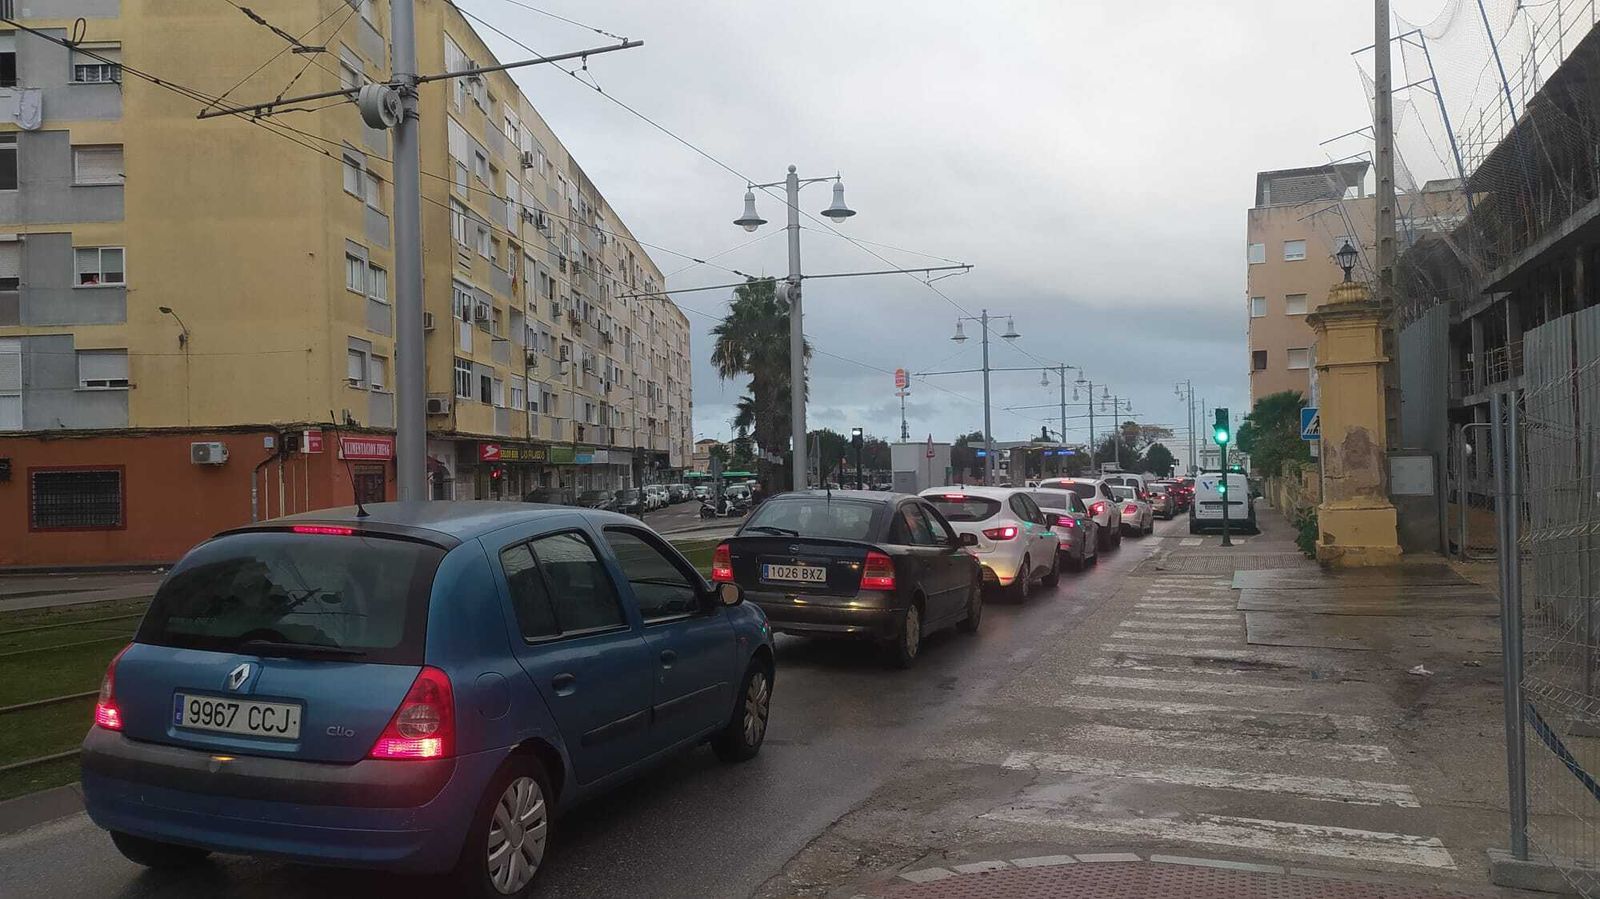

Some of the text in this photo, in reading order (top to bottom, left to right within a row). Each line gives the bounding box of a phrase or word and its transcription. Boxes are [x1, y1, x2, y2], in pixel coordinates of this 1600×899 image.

[771, 566, 824, 580] 1026 BXZ
[189, 700, 290, 733] 9967 CCJ
[326, 725, 355, 738] Clio
